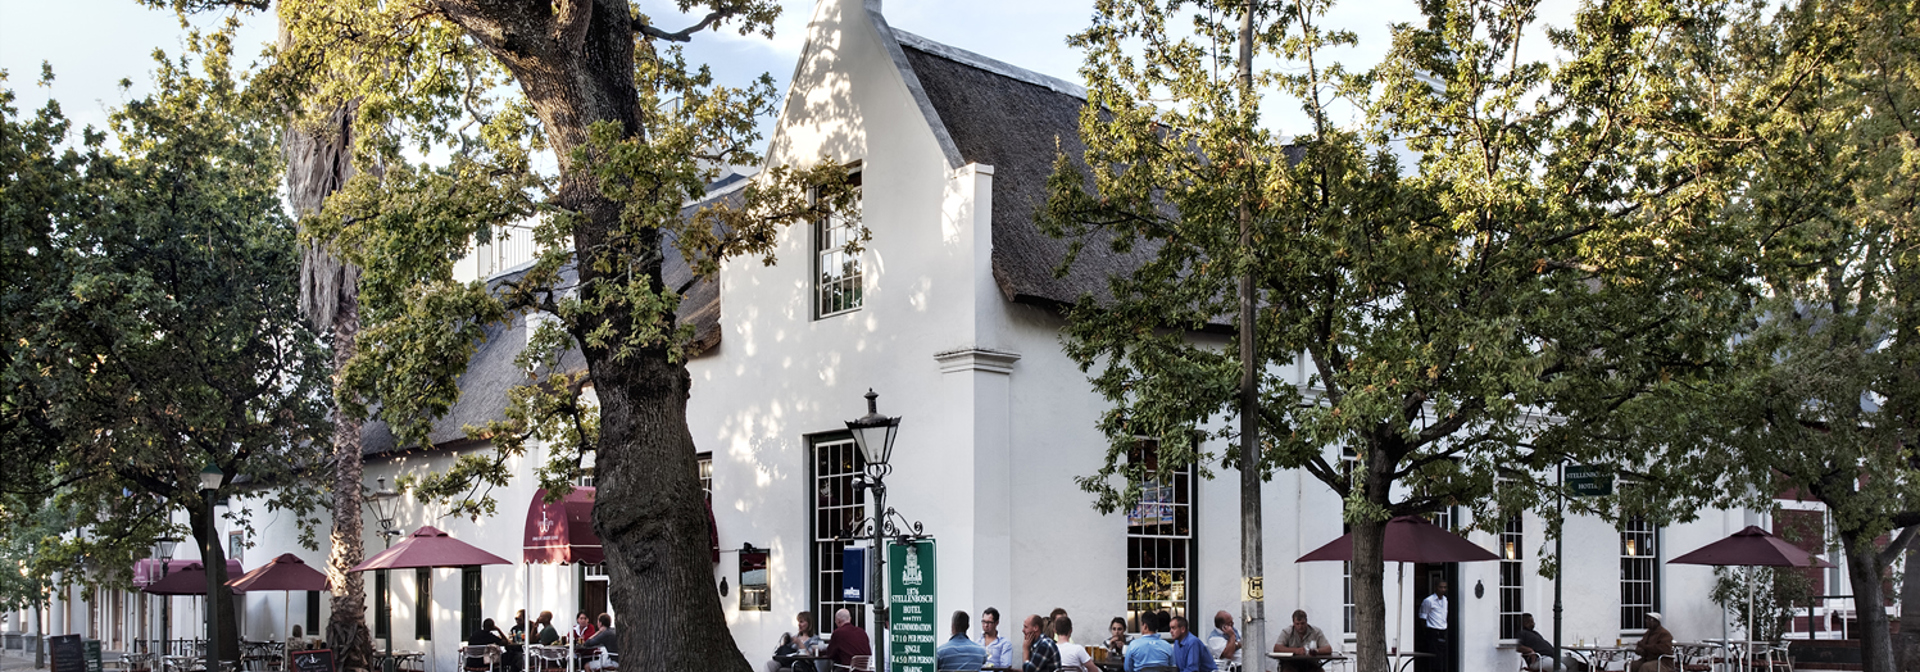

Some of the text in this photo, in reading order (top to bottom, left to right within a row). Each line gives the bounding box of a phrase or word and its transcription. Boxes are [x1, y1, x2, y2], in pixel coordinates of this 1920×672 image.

[1252, 581, 1262, 590] H
[892, 595, 933, 603] STELLENBOSCH
[903, 606, 921, 614] HOTEL
[893, 623, 932, 631] ACCOMMODATION
[908, 634, 917, 643] PER
[917, 634, 935, 643] PERSON
[905, 645, 920, 653] SINGLE
[908, 655, 917, 664] PER
[917, 655, 935, 664] PERSON
